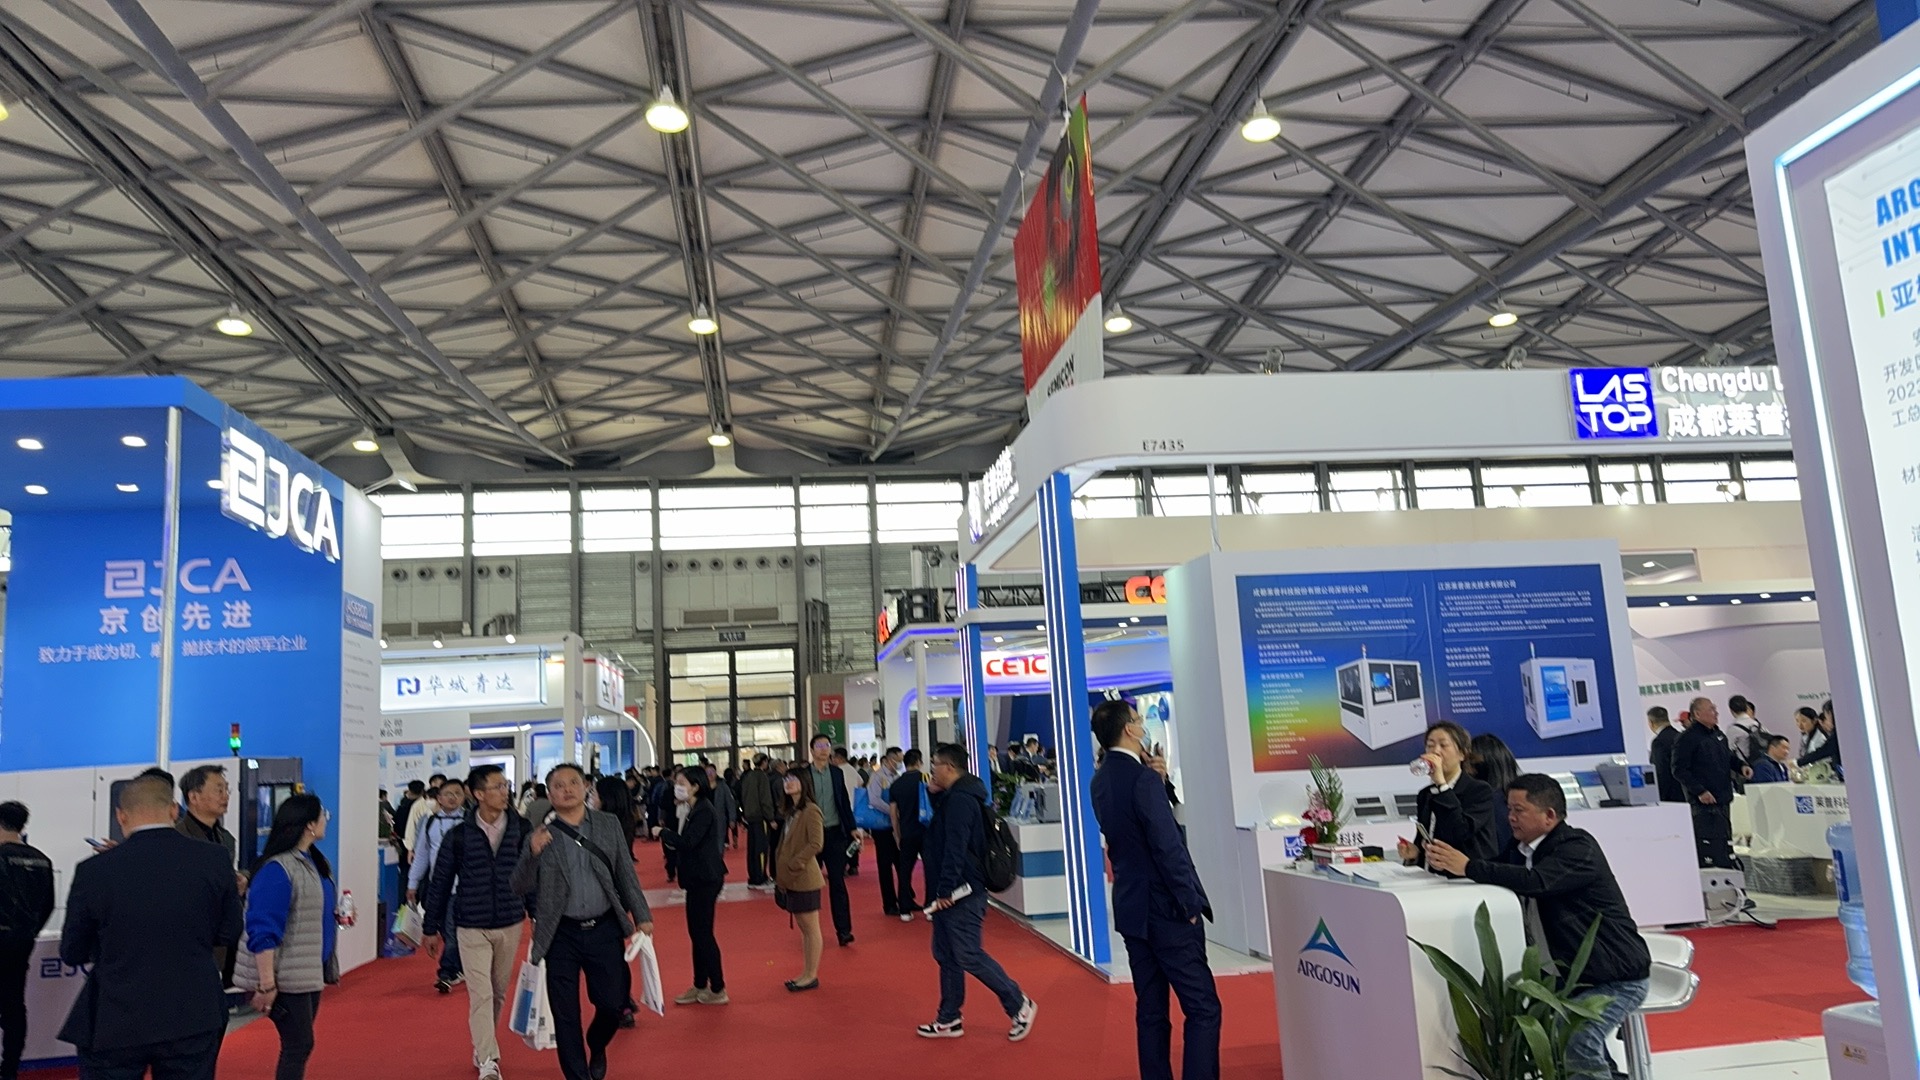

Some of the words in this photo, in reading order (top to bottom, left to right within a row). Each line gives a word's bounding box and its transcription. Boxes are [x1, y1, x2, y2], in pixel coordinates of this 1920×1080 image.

[1891, 274, 1920, 312] 亚
[1576, 374, 1648, 403] LAS
[1661, 366, 1768, 398] Chengdu
[1580, 404, 1653, 433] TOP
[1667, 402, 1790, 438] 成都莱普
[1142, 439, 1184, 452] E7435
[821, 700, 840, 715] E7
[687, 731, 703, 744] E6
[1297, 957, 1361, 995] ARGOSUN
